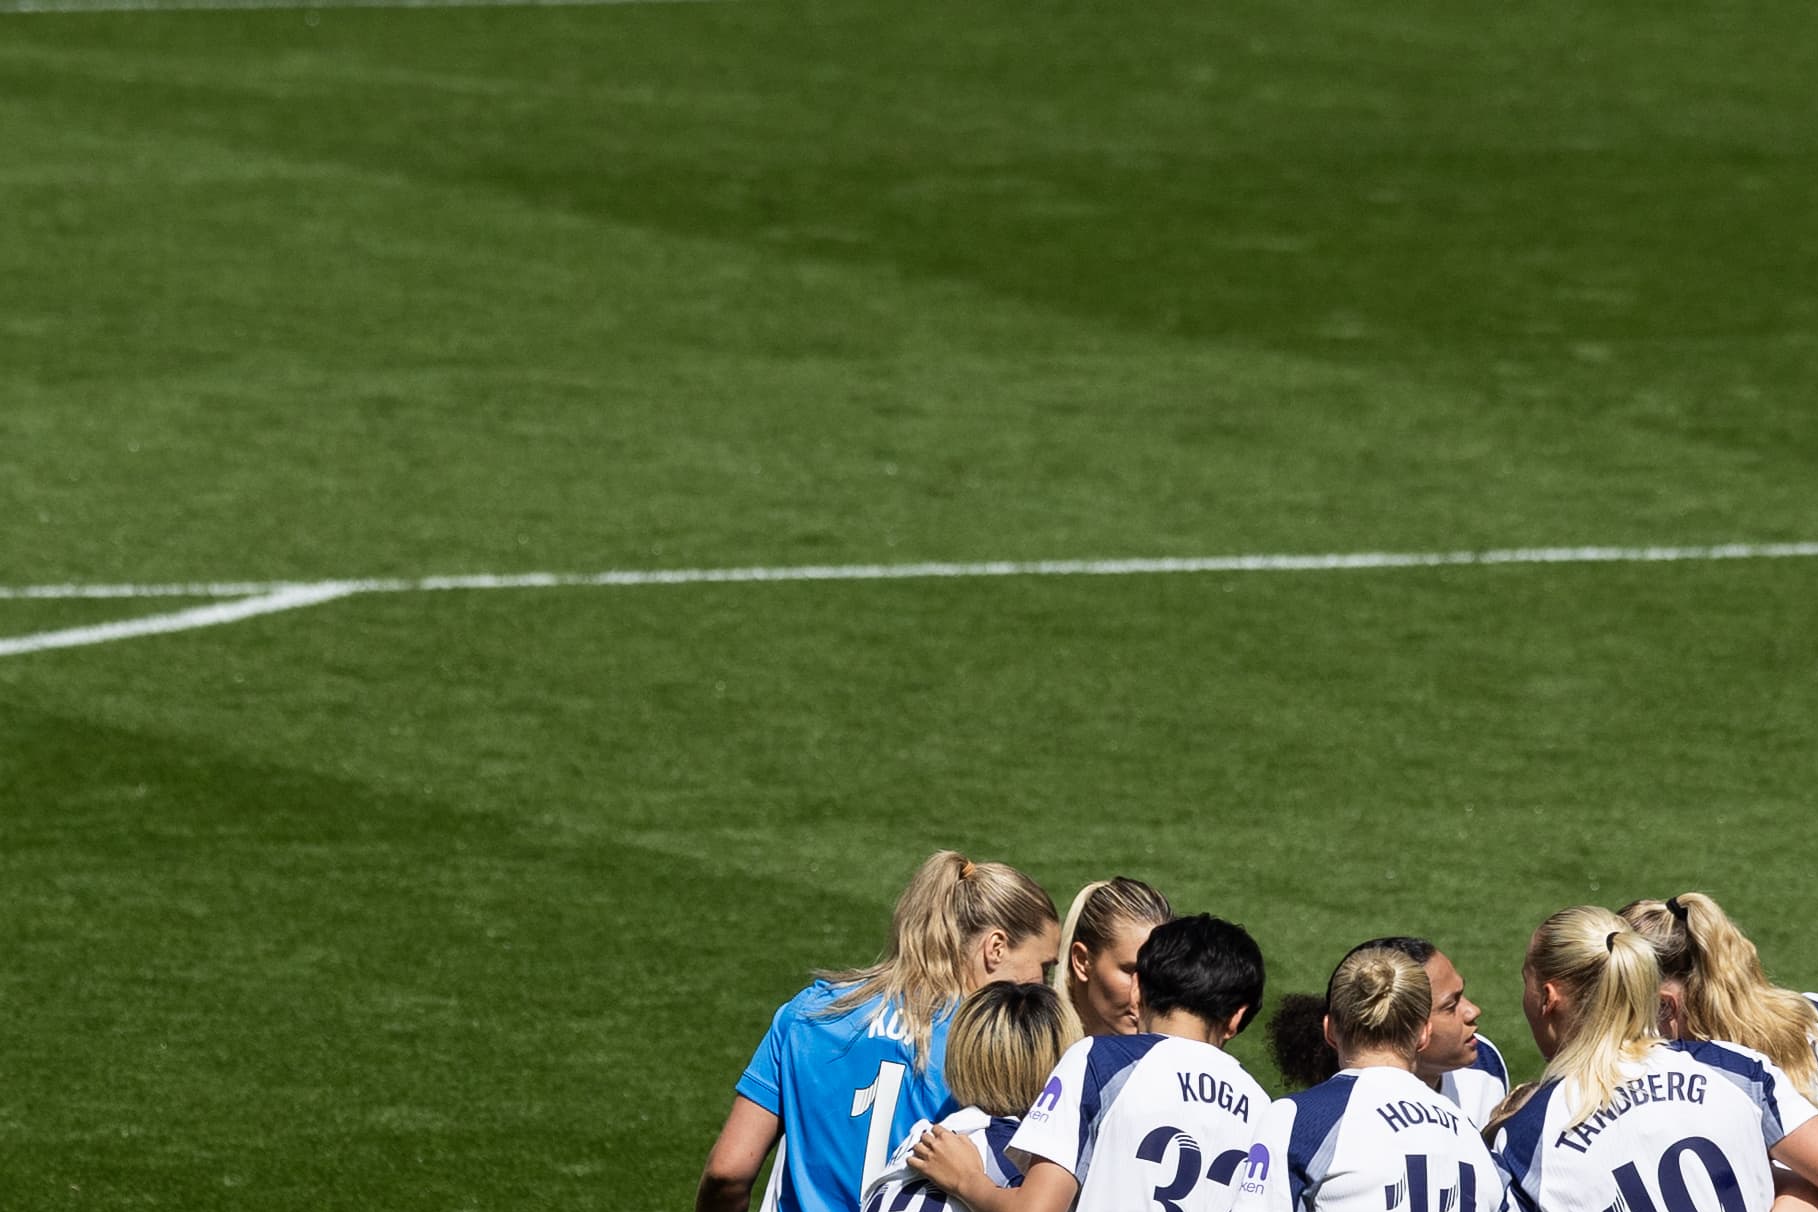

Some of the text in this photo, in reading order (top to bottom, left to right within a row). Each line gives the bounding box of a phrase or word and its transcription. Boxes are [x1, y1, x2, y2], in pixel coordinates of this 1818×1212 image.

[1177, 1072, 1249, 1123] KOGA
[1376, 1100, 1460, 1136] HOLDT
[1554, 1071, 1708, 1154] TANDBERG
[850, 1060, 907, 1208] 1
